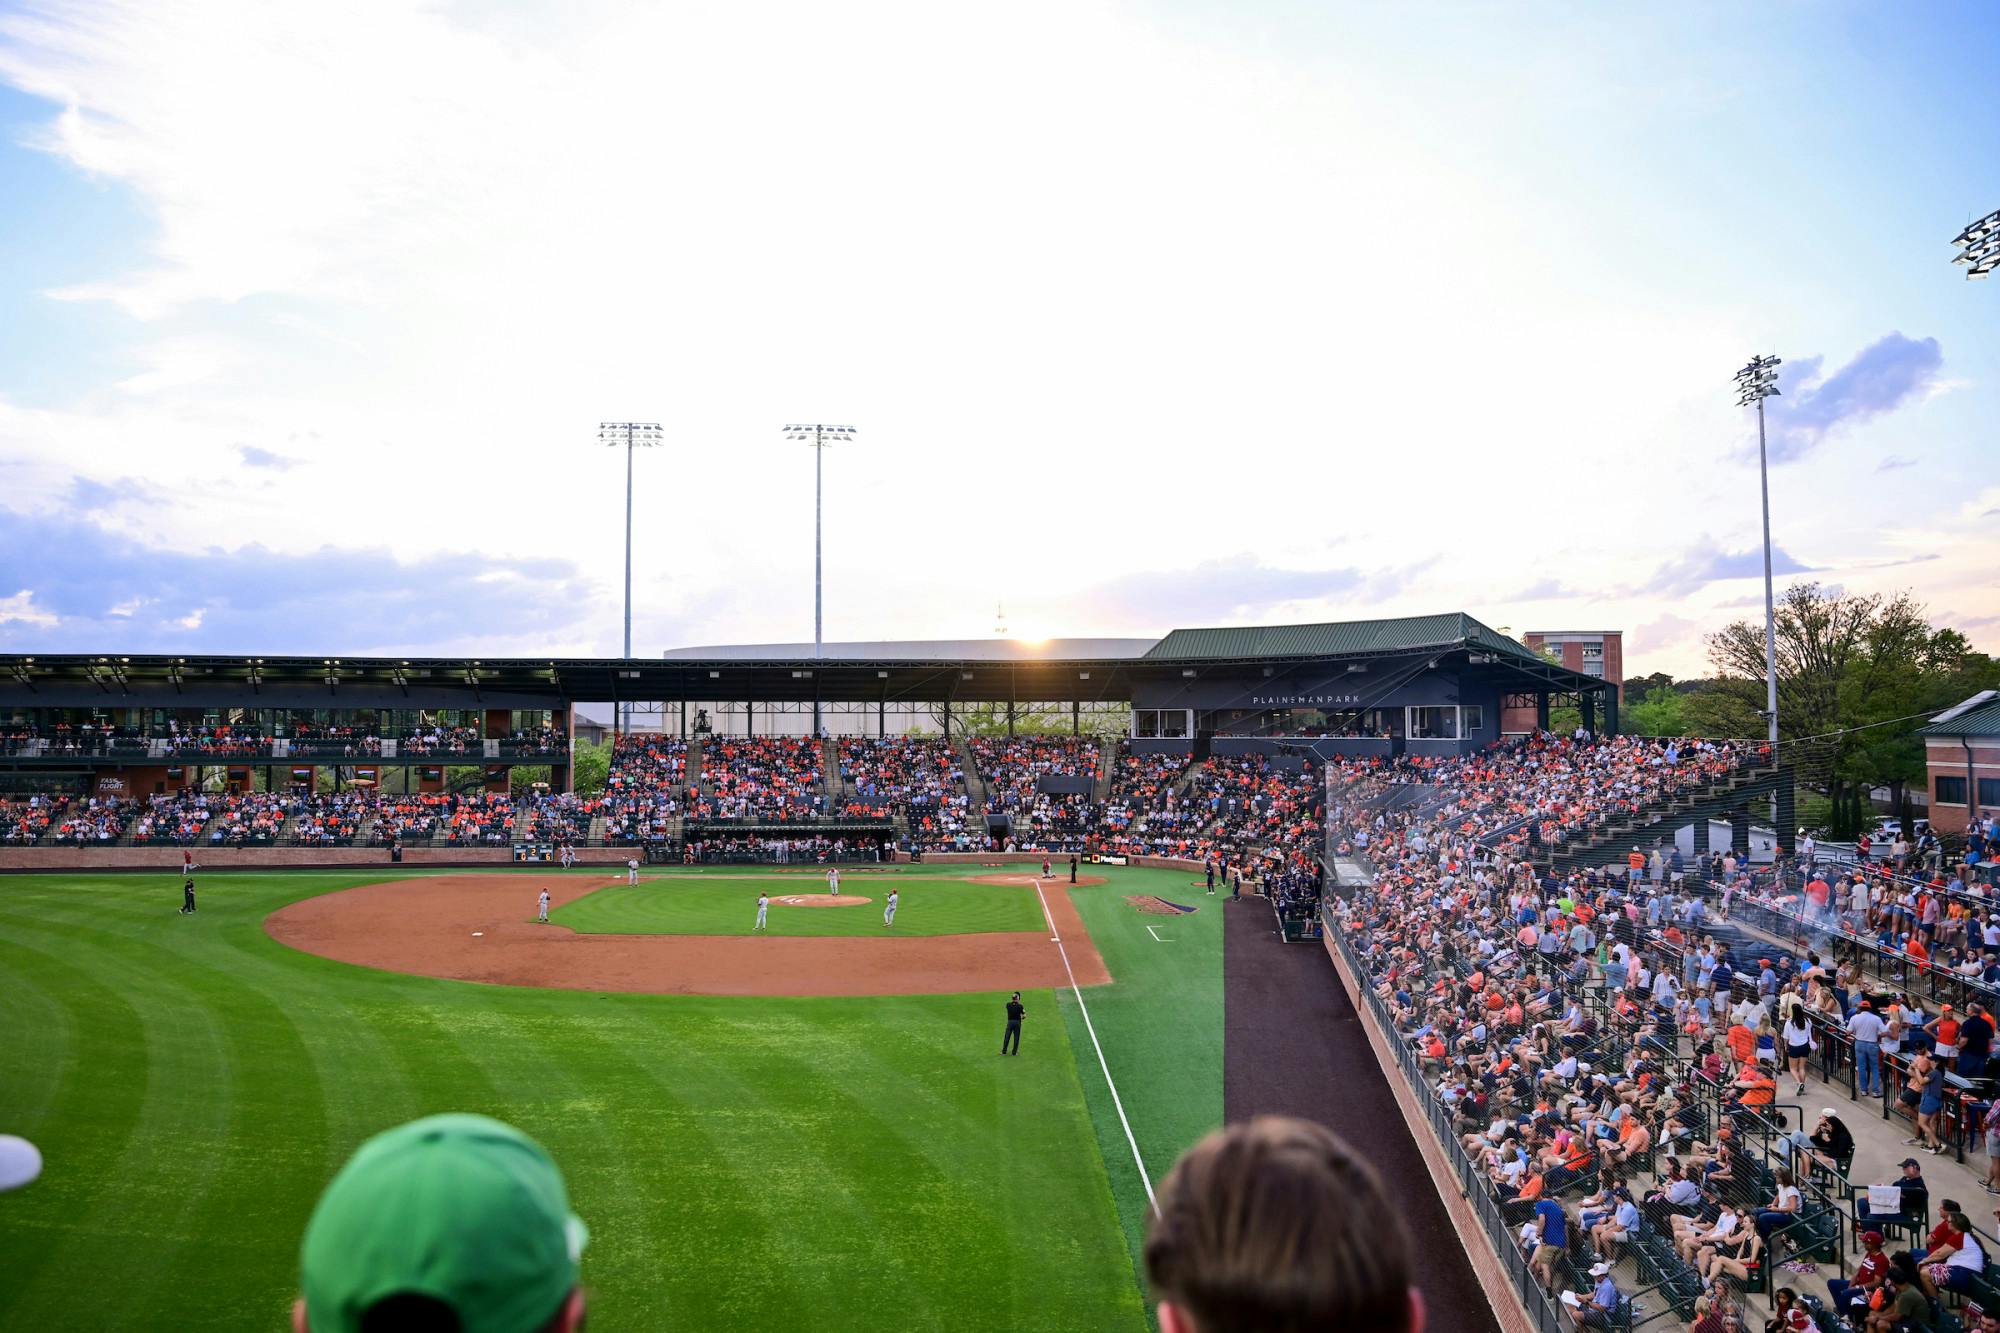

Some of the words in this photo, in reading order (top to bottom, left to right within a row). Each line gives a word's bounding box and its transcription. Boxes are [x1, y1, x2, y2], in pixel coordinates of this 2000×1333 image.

[1253, 696, 1323, 704] PLAINSMAN
[1327, 695, 1359, 703] PARK
[521, 852, 526, 861] 0
[531, 848, 536, 856] 2
[546, 852, 551, 861] 6
[1100, 855, 1126, 863] Piedmont
